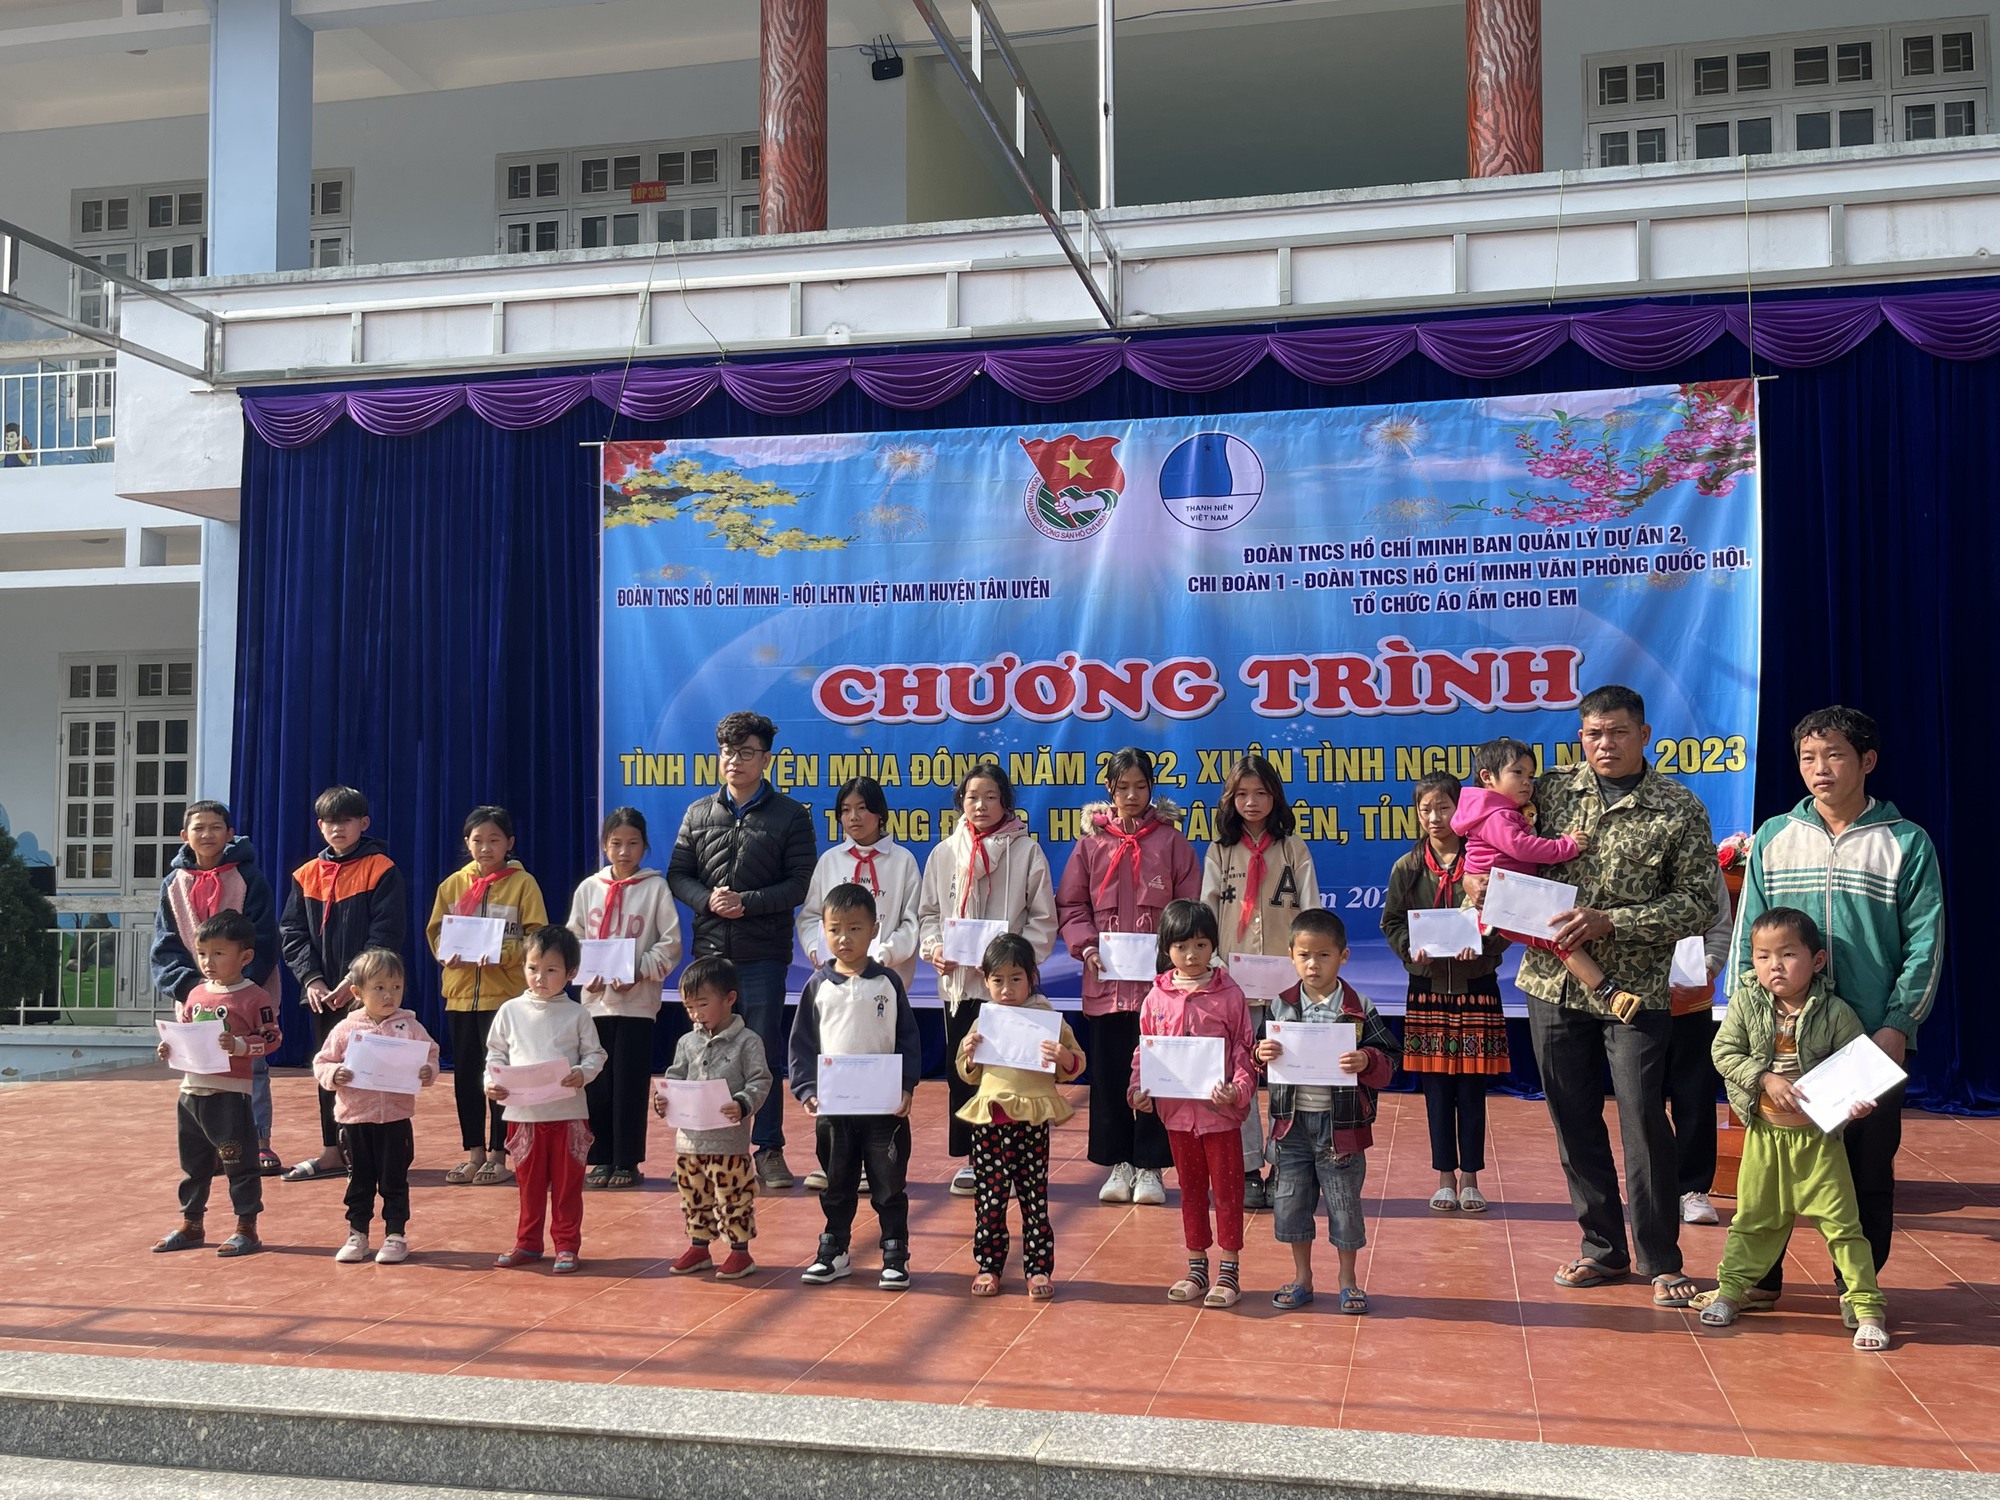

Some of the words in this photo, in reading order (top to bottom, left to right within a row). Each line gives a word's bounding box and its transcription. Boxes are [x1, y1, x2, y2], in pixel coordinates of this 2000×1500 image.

[1185, 504, 1212, 512] THANH
[1214, 503, 1234, 511] NIÊN
[1190, 513, 1208, 522] VIỆT
[1244, 542, 1292, 564] ĐOÀN
[1299, 543, 1344, 562] TNCS
[1350, 537, 1375, 560] HỒ
[1381, 537, 1411, 558] CHÍ
[1417, 538, 1467, 557] MINH
[1472, 535, 1512, 554] BAN
[1518, 529, 1570, 553] QUẢN
[1576, 527, 1600, 548] LÝ
[1605, 527, 1632, 551] DỰ
[1636, 525, 1663, 546] ÁN
[1668, 526, 1687, 546] 2,
[1188, 576, 1216, 593] CHI
[1222, 569, 1270, 592] ĐOÀN
[1275, 574, 1284, 590] 1
[1304, 567, 1354, 589] ĐOÀN
[1360, 568, 1407, 587] TNCS
[1414, 561, 1437, 584] HỒ
[1444, 560, 1475, 583] CHÍ
[1481, 562, 1532, 581] MINH
[1538, 557, 1576, 579] VĂN
[1583, 554, 1649, 577] PHÒNG
[1655, 547, 1706, 574] QUỐC
[1712, 547, 1751, 571] HỘI,
[617, 584, 652, 606] ĐOÀN
[658, 587, 689, 606] TNCS
[694, 582, 712, 606] HỒ
[716, 583, 739, 605] CHÍ
[743, 586, 779, 605] MINH
[793, 583, 816, 608] HỘI
[821, 584, 855, 604] LHTN
[859, 581, 888, 606] VIỆT
[892, 583, 925, 602] NAM
[929, 579, 975, 605] HUYỆN
[979, 577, 1007, 600] TÂN
[1011, 576, 1050, 599] UYÊN
[1353, 590, 1375, 615] TỔ
[1381, 591, 1430, 614] CHỨC
[1436, 591, 1461, 612] ÁO
[1467, 586, 1497, 610] ẤM
[1503, 590, 1542, 609] CHO
[1547, 588, 1577, 607] EM
[815, 652, 1223, 720] CHƯƠNG
[1244, 637, 1581, 712] TRÌNH
[619, 747, 685, 786] TÌNH
[694, 746, 818, 793] NYỆN
[829, 747, 902, 786] MÙA
[1009, 745, 1086, 787] NĂM
[1302, 740, 1385, 783] TÌNH
[1654, 734, 1747, 774] 2023
[824, 808, 930, 843] TNG
[1359, 795, 1425, 842] TỈN
[1269, 864, 1300, 909] A
